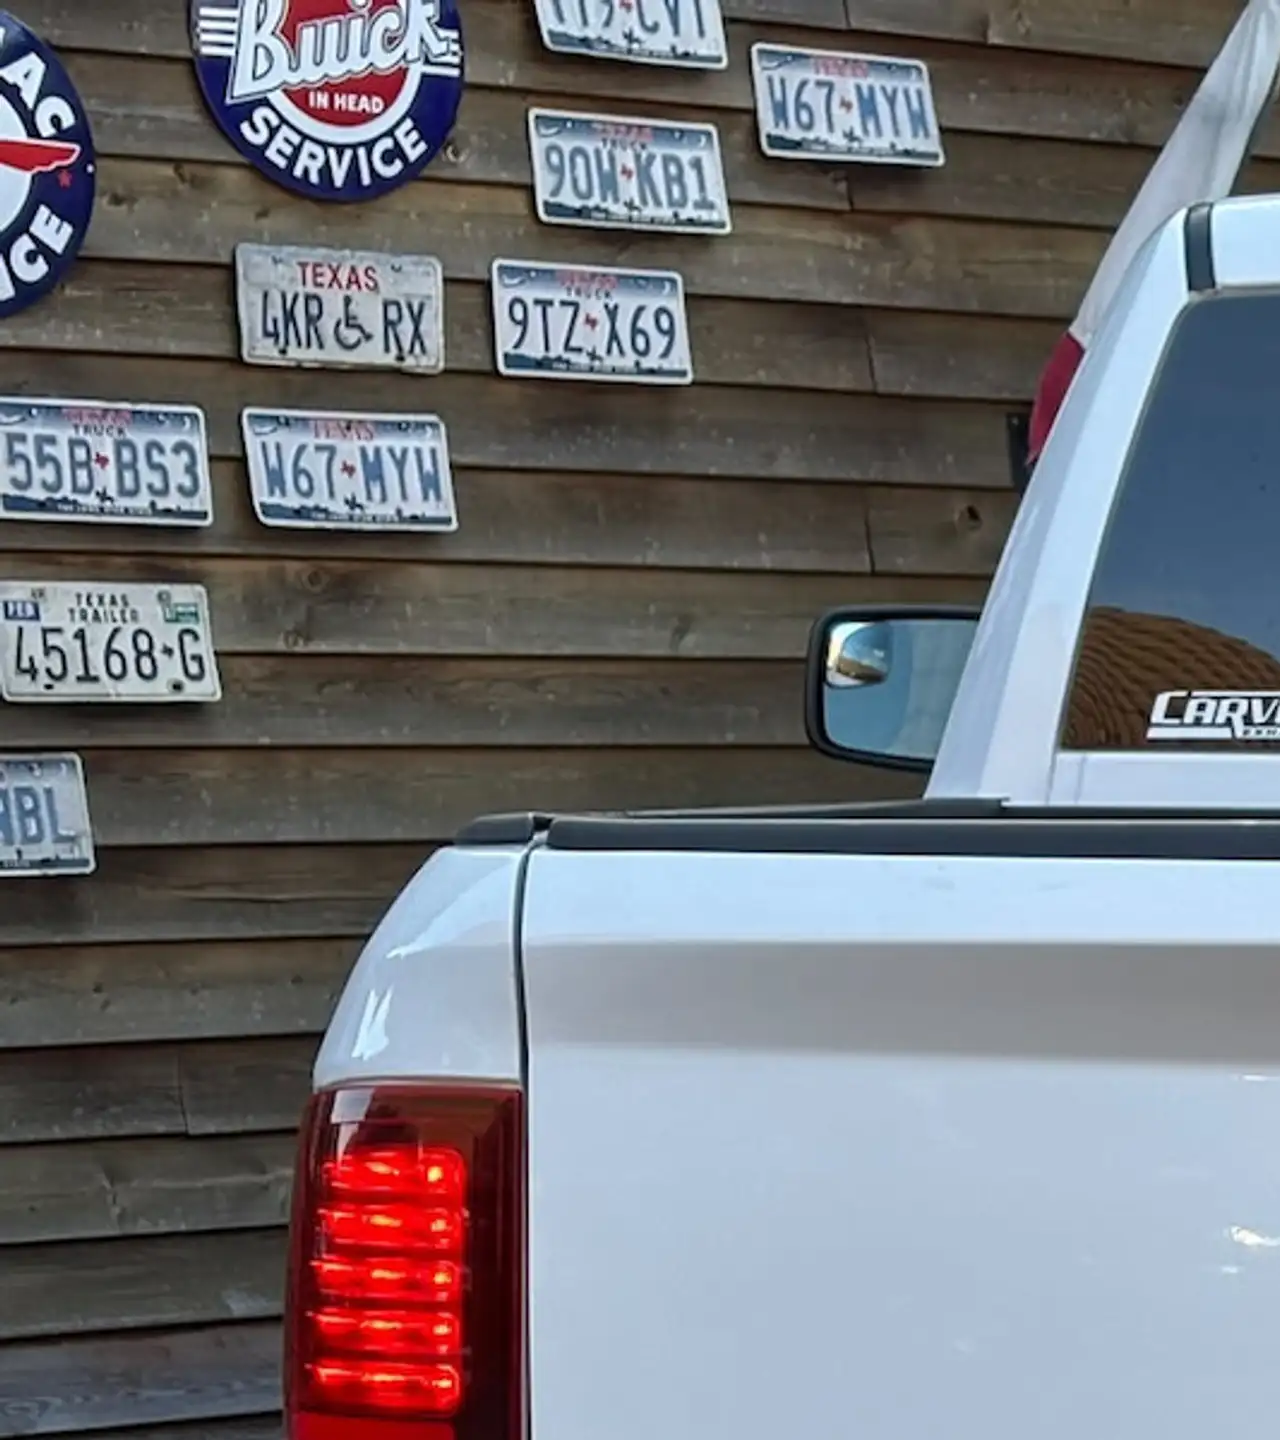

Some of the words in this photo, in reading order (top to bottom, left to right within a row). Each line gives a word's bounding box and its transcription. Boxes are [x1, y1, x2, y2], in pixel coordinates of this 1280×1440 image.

[230, 0, 452, 101] Buick
[309, 91, 329, 110] IN
[337, 94, 384, 113] HEAD
[766, 75, 835, 133] W67
[854, 82, 930, 139] MYW
[240, 106, 427, 188] SERVICE
[634, 152, 715, 210] KB1
[299, 262, 379, 292] TEXAS
[262, 290, 324, 351] 4KR
[383, 300, 427, 356] RX
[508, 297, 583, 353] 9TZ
[604, 303, 676, 359] X69
[73, 424, 127, 437] TRUCK
[6, 432, 94, 495] 55B
[113, 438, 200, 498] BS3
[261, 441, 337, 498] W67
[360, 445, 441, 503] MYW
[68, 608, 140, 623] TRAILER
[76, 592, 130, 608] TEXAS
[15, 626, 158, 682] 45168
[178, 628, 205, 682] G
